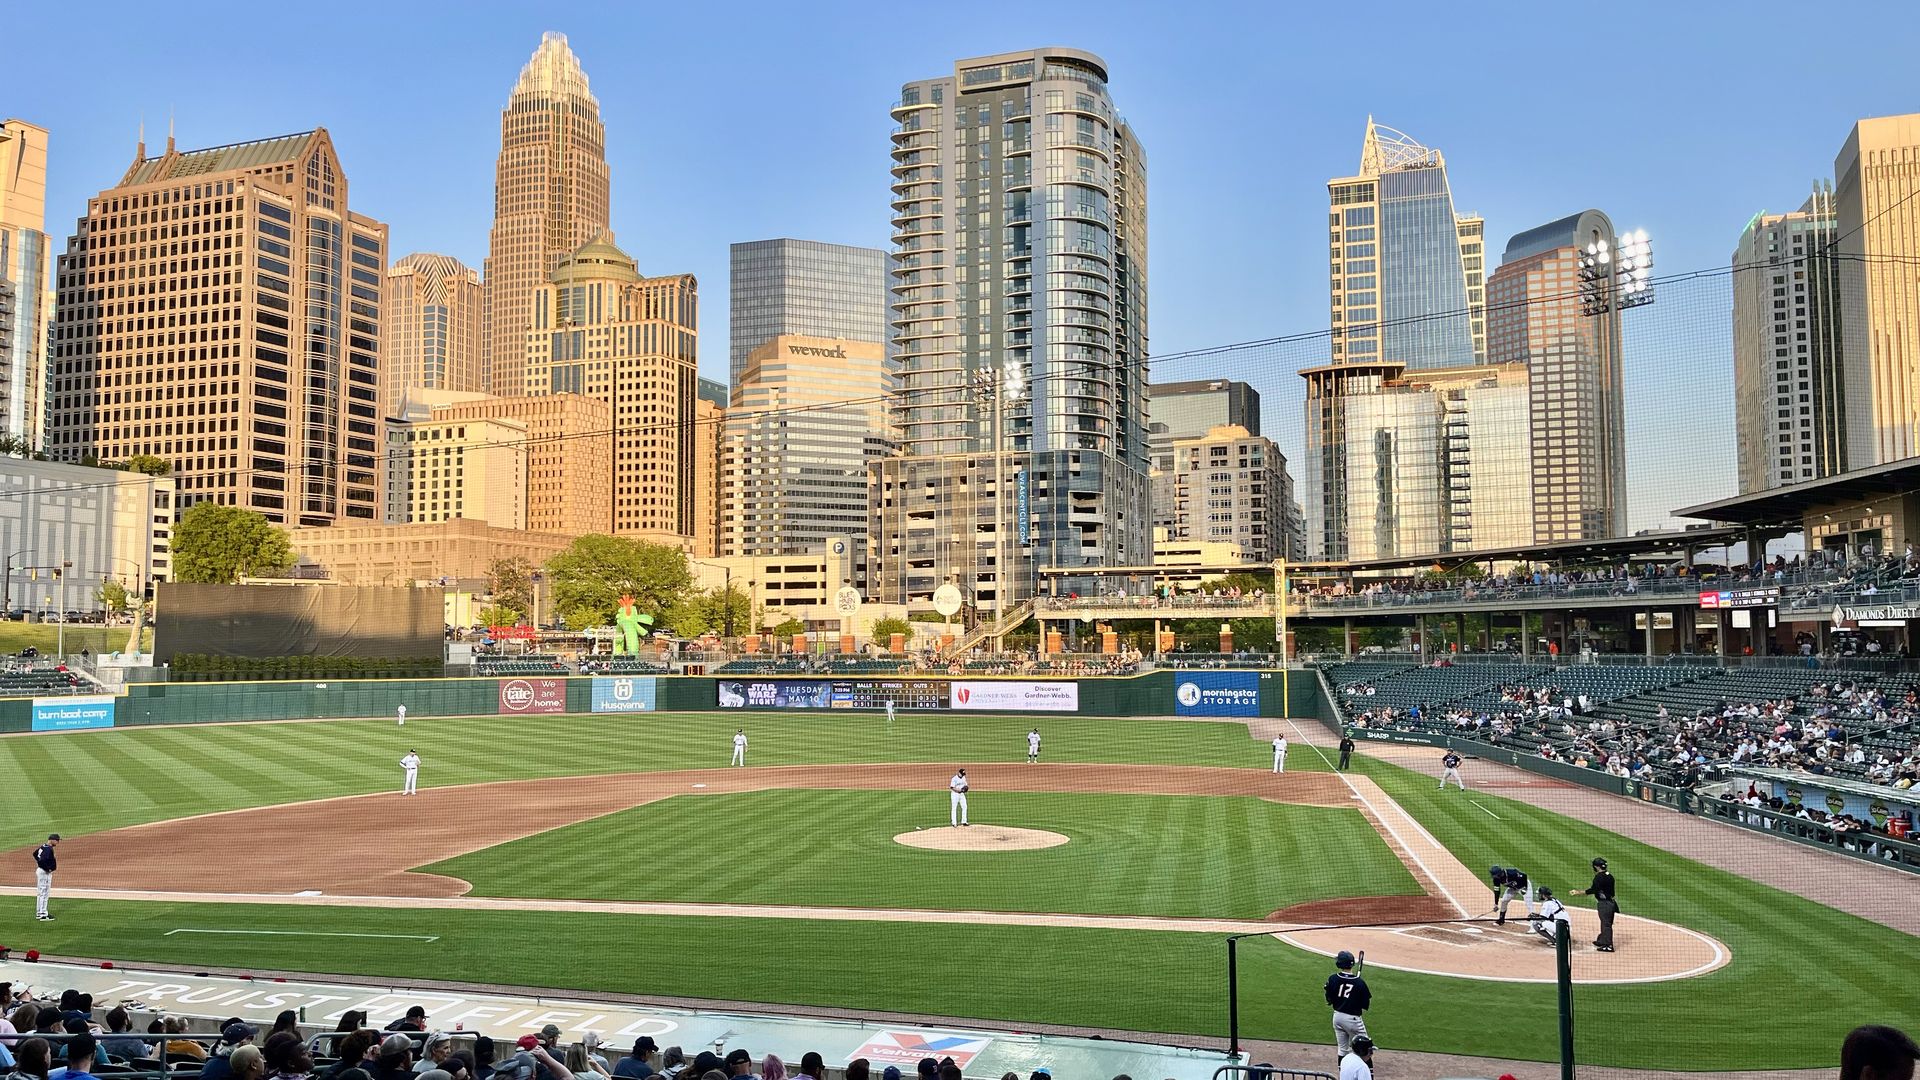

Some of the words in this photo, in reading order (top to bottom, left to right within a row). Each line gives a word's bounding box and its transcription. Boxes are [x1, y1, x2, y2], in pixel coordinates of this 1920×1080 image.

[788, 345, 847, 359] wework
[835, 543, 842, 552] P
[1846, 607, 1885, 620] DIAMONDS
[1887, 605, 1916, 619] DIRECT
[751, 683, 775, 691] STAR
[507, 687, 531, 699] tate
[748, 690, 777, 699] WARS
[1202, 688, 1256, 698] morningstar
[601, 701, 645, 710] Husqvarna
[38, 710, 59, 719] burn
[60, 709, 81, 718] boot
[82, 710, 108, 719] camp
[1366, 732, 1389, 740] SHARP
[95, 980, 352, 1009] TRUIST
[1338, 983, 1354, 998] 12
[446, 1006, 679, 1037] FIELD
